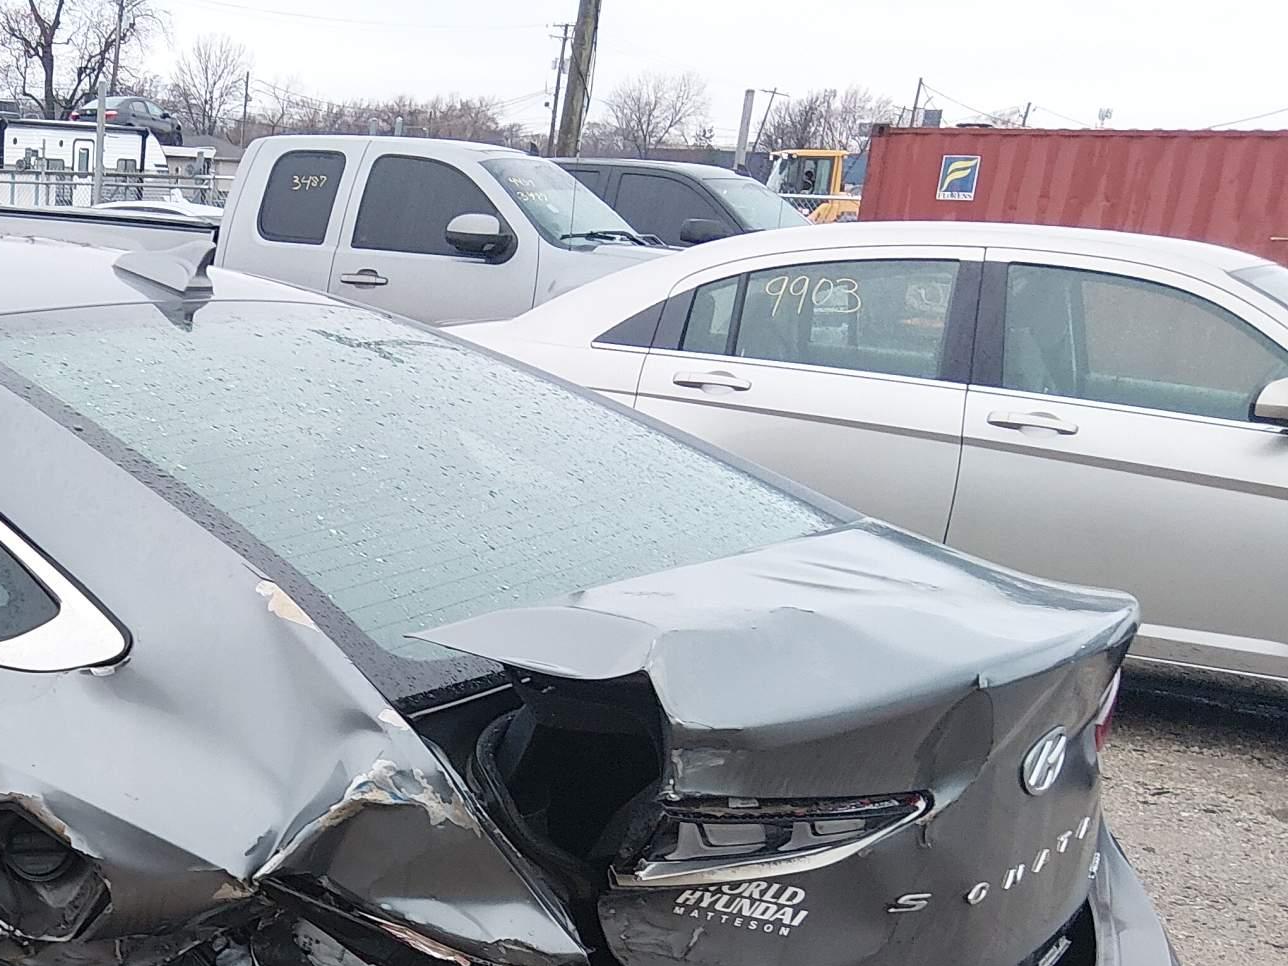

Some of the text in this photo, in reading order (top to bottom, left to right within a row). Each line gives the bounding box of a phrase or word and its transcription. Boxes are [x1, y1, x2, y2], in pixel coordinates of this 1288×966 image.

[292, 175, 328, 191] 3487
[765, 275, 862, 318] 9903
[675, 889, 809, 927] HYUNDAI
[698, 880, 806, 906] ORLD
[672, 906, 791, 937] MATTESON
